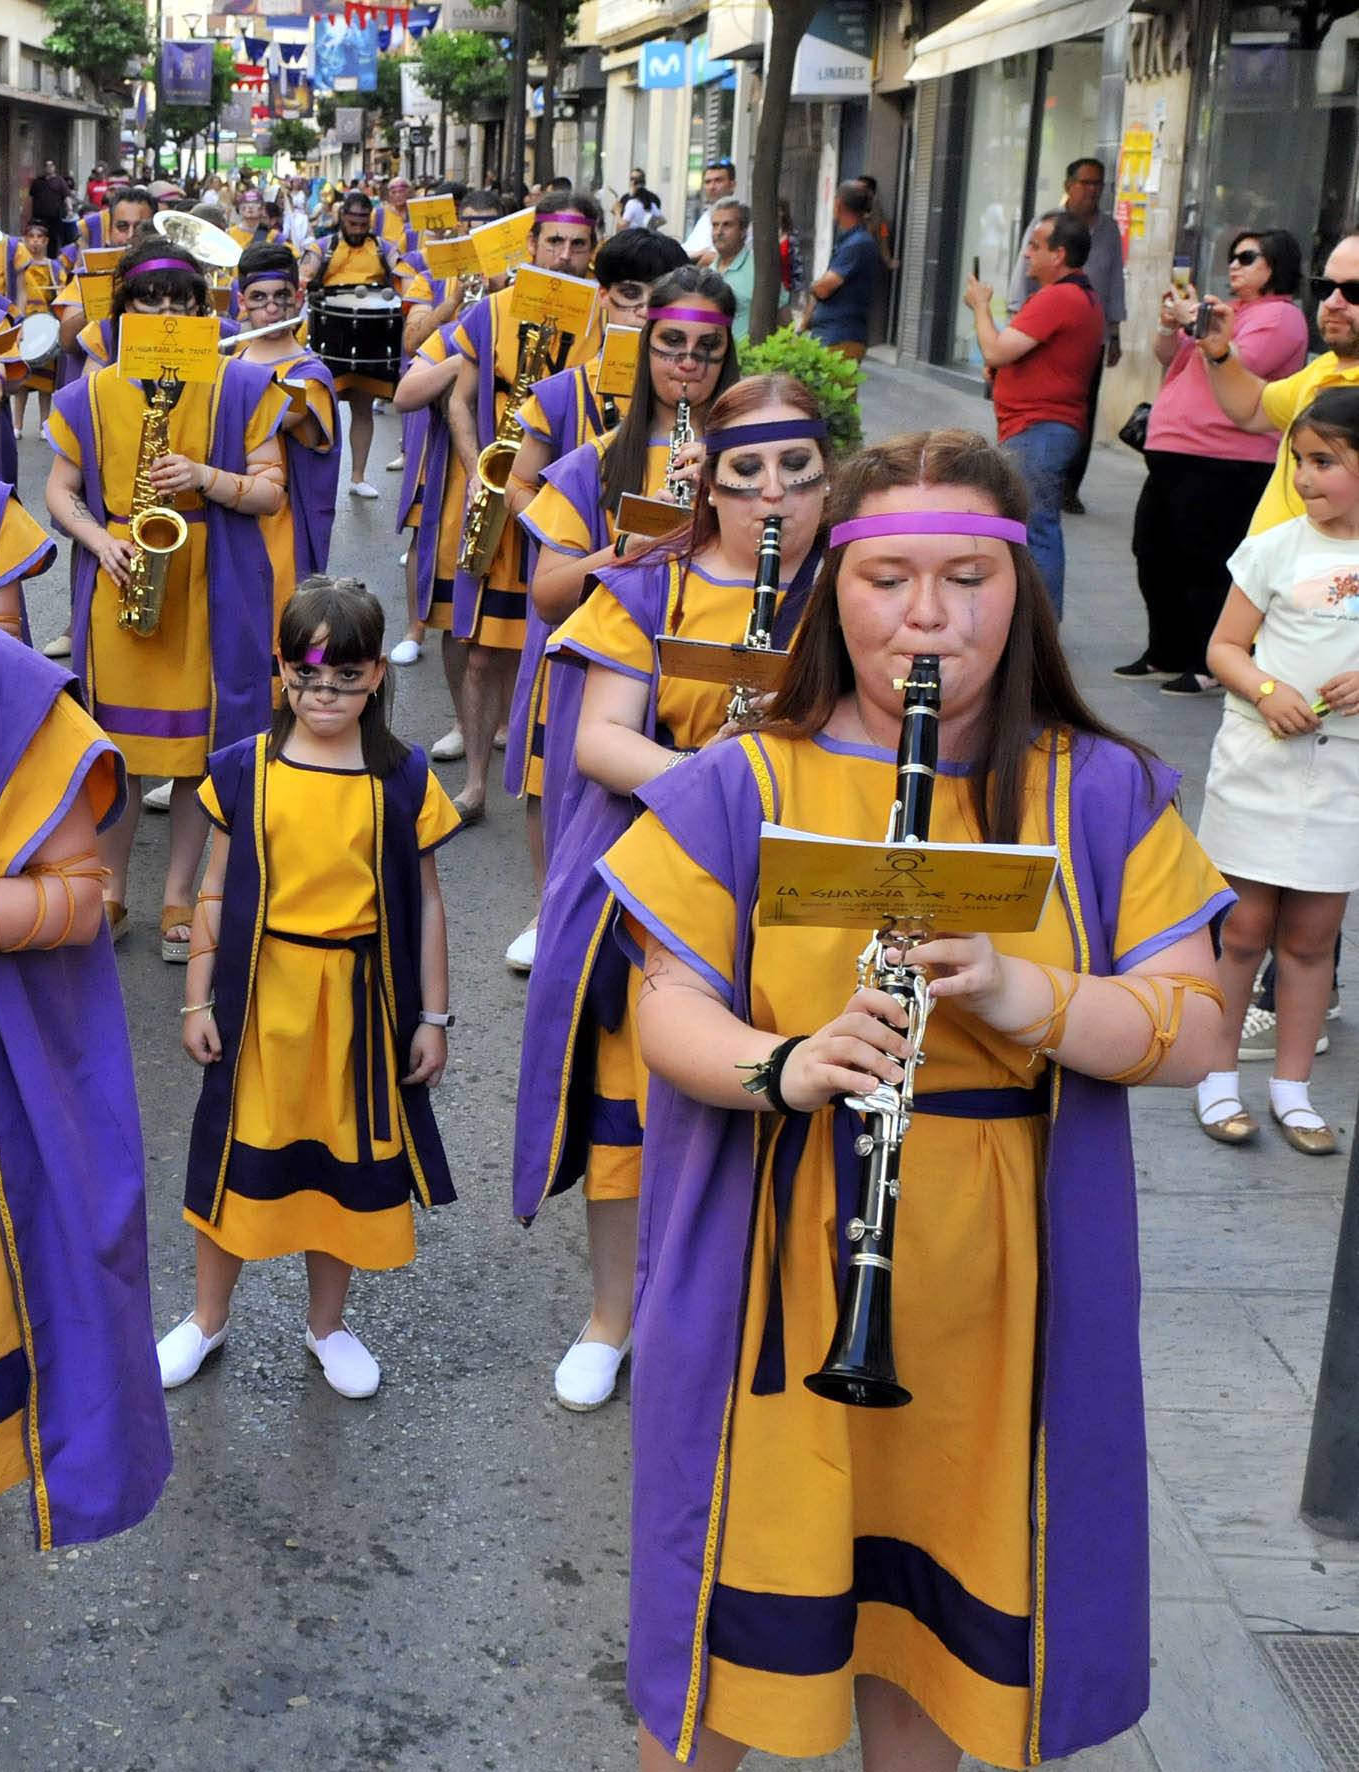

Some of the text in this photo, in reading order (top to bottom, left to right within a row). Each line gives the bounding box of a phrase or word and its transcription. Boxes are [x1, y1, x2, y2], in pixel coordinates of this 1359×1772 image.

[817, 66, 866, 81] LINARES
[776, 886, 800, 897] LA
[810, 888, 905, 899] GUARDIA
[959, 891, 1030, 902] TANIT
